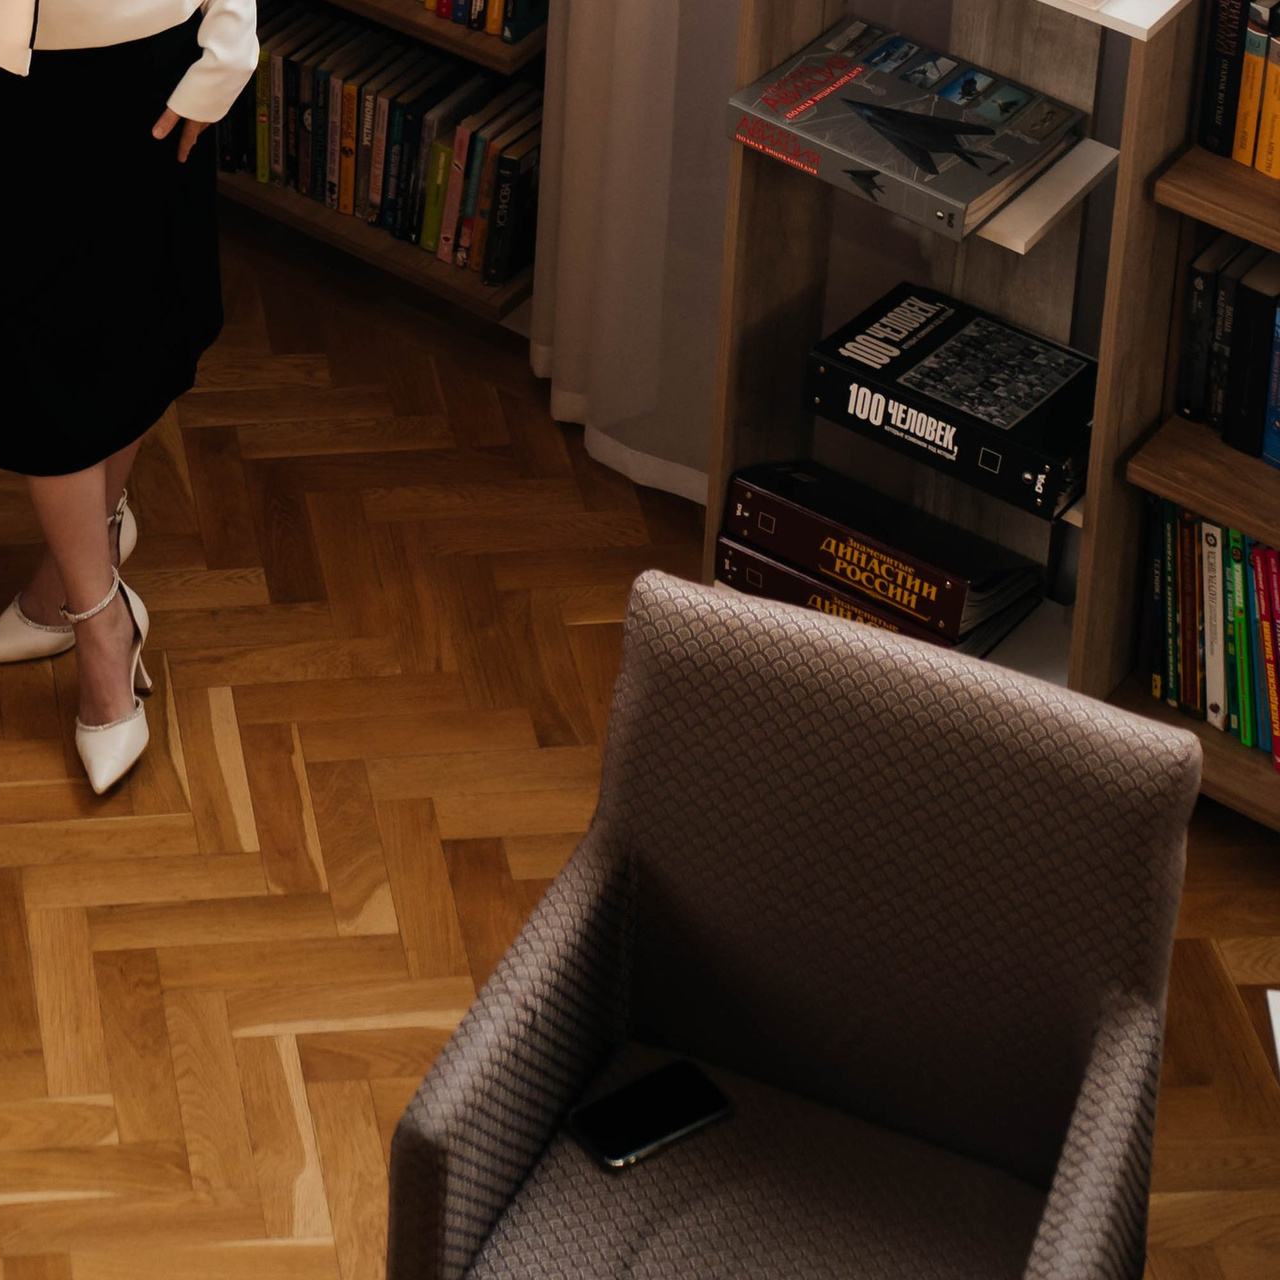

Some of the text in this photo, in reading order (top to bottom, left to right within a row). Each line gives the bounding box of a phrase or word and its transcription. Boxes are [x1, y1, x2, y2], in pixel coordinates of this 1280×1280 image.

[1228, 0, 1242, 56] РИЧАРД
[784, 63, 865, 120] ПОЛНАЯ ЭНЦИКЛОПЕДИЯ
[364, 94, 373, 145] УСТИНОВА
[734, 132, 818, 176] ПОЛНАЯ ЭНЦИКЛОПЕДИЯ
[498, 182, 512, 228] УСТИНОВА
[839, 334, 901, 370] 100
[847, 383, 959, 458] 100 ЧЕЛОВЕК,
[820, 537, 938, 601] ДИНАСТИИ
[847, 537, 915, 574] Знаменитые
[834, 557, 918, 609] РОССИИ
[830, 595, 899, 633] Знаменитые
[1261, 620, 1280, 735] КАЛЕЙДОСКОП ЗНАНИЙ
